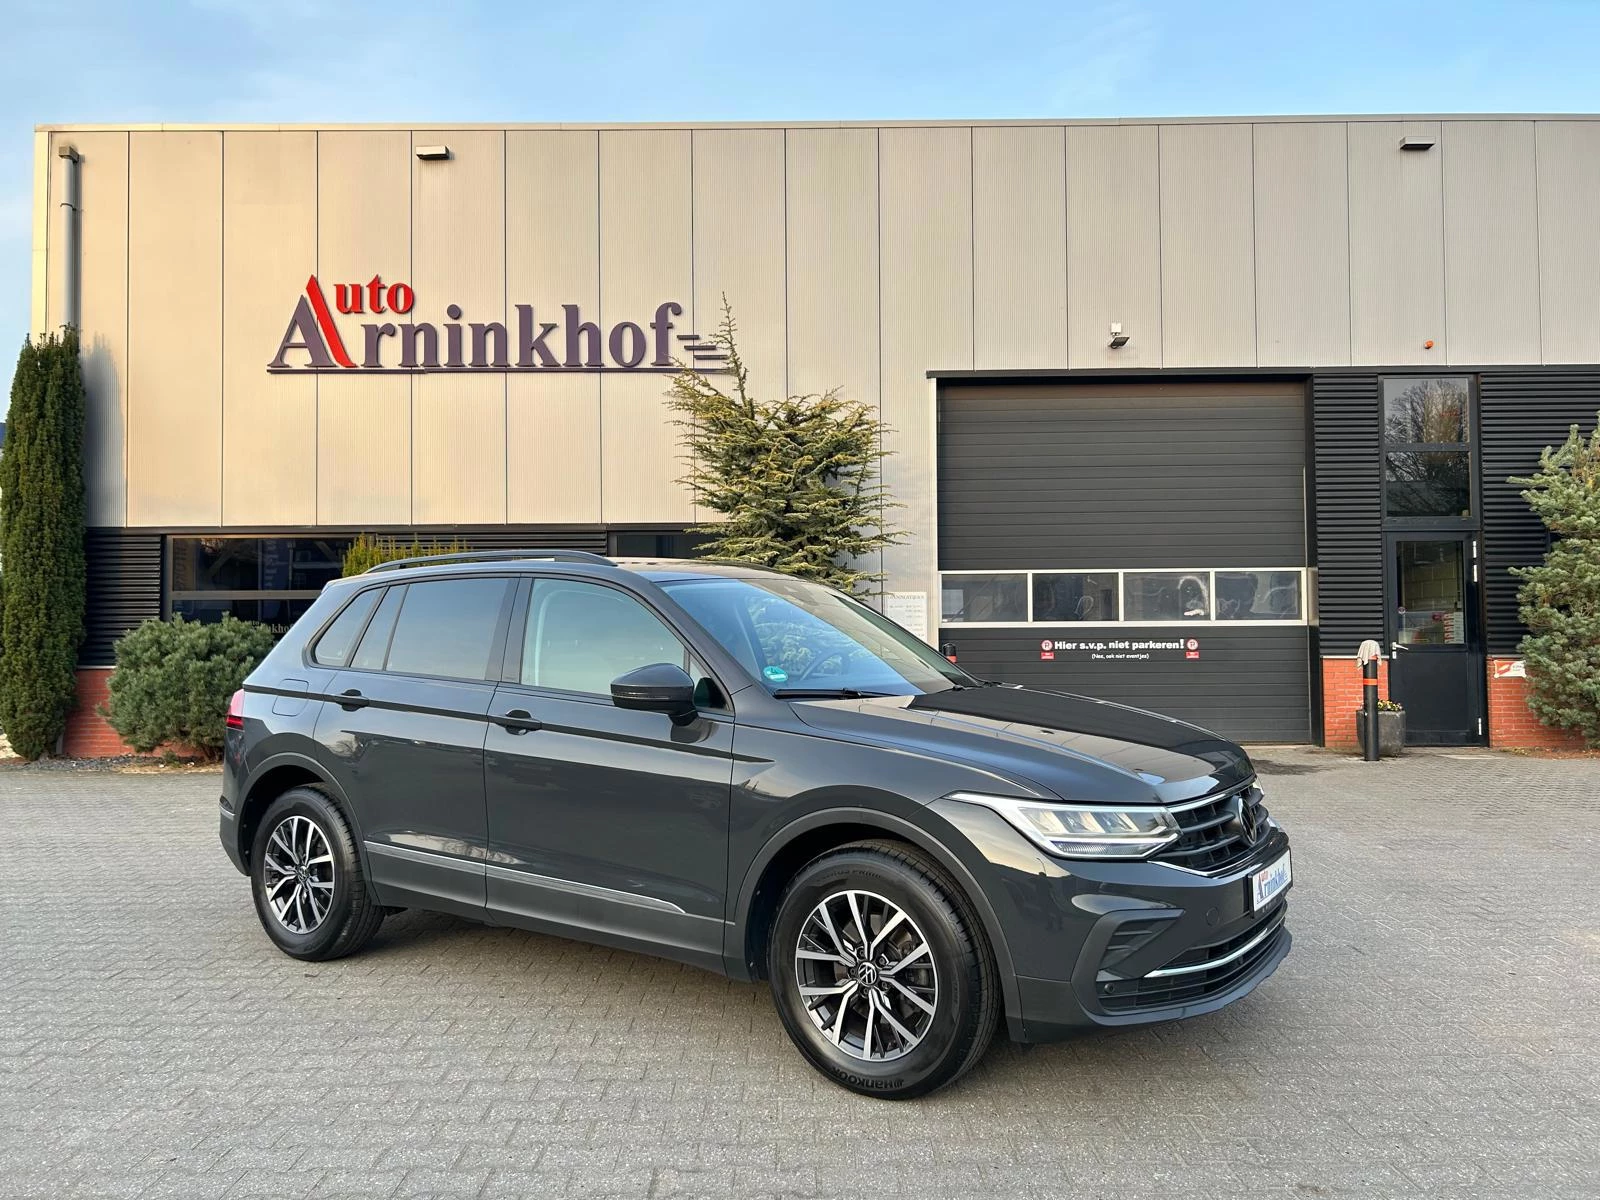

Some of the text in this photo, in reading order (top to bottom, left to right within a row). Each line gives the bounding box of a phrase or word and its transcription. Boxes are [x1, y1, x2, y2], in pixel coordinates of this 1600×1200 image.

[267, 294, 683, 368] Arninkhof
[1054, 638, 1184, 651] Hier s.v.p. niet parkeren!
